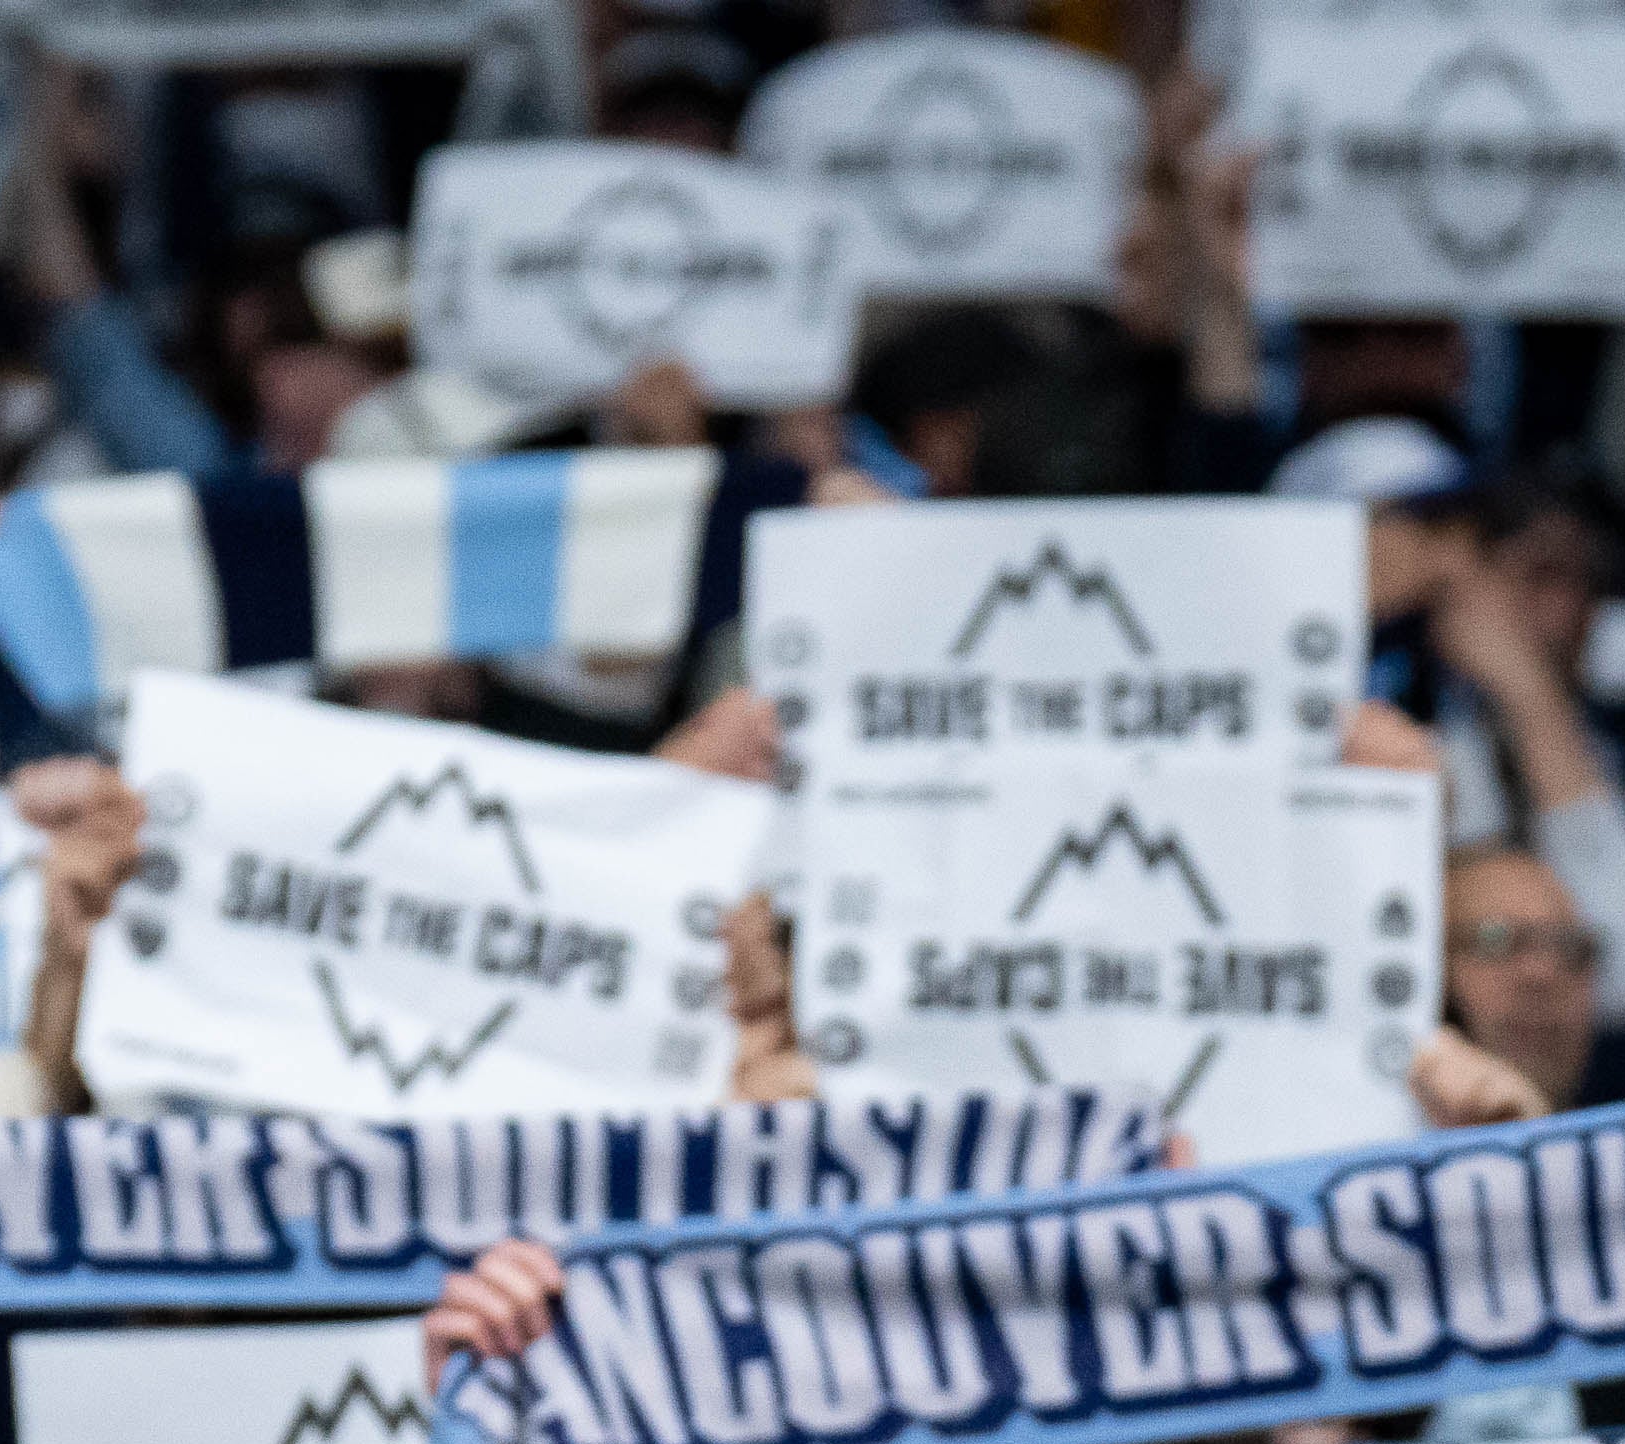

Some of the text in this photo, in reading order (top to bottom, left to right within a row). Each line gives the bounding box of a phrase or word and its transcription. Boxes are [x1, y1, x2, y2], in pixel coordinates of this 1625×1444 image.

[1101, 672, 1253, 740] CAPS
[222, 852, 631, 1001] SAVE THE CAPS
